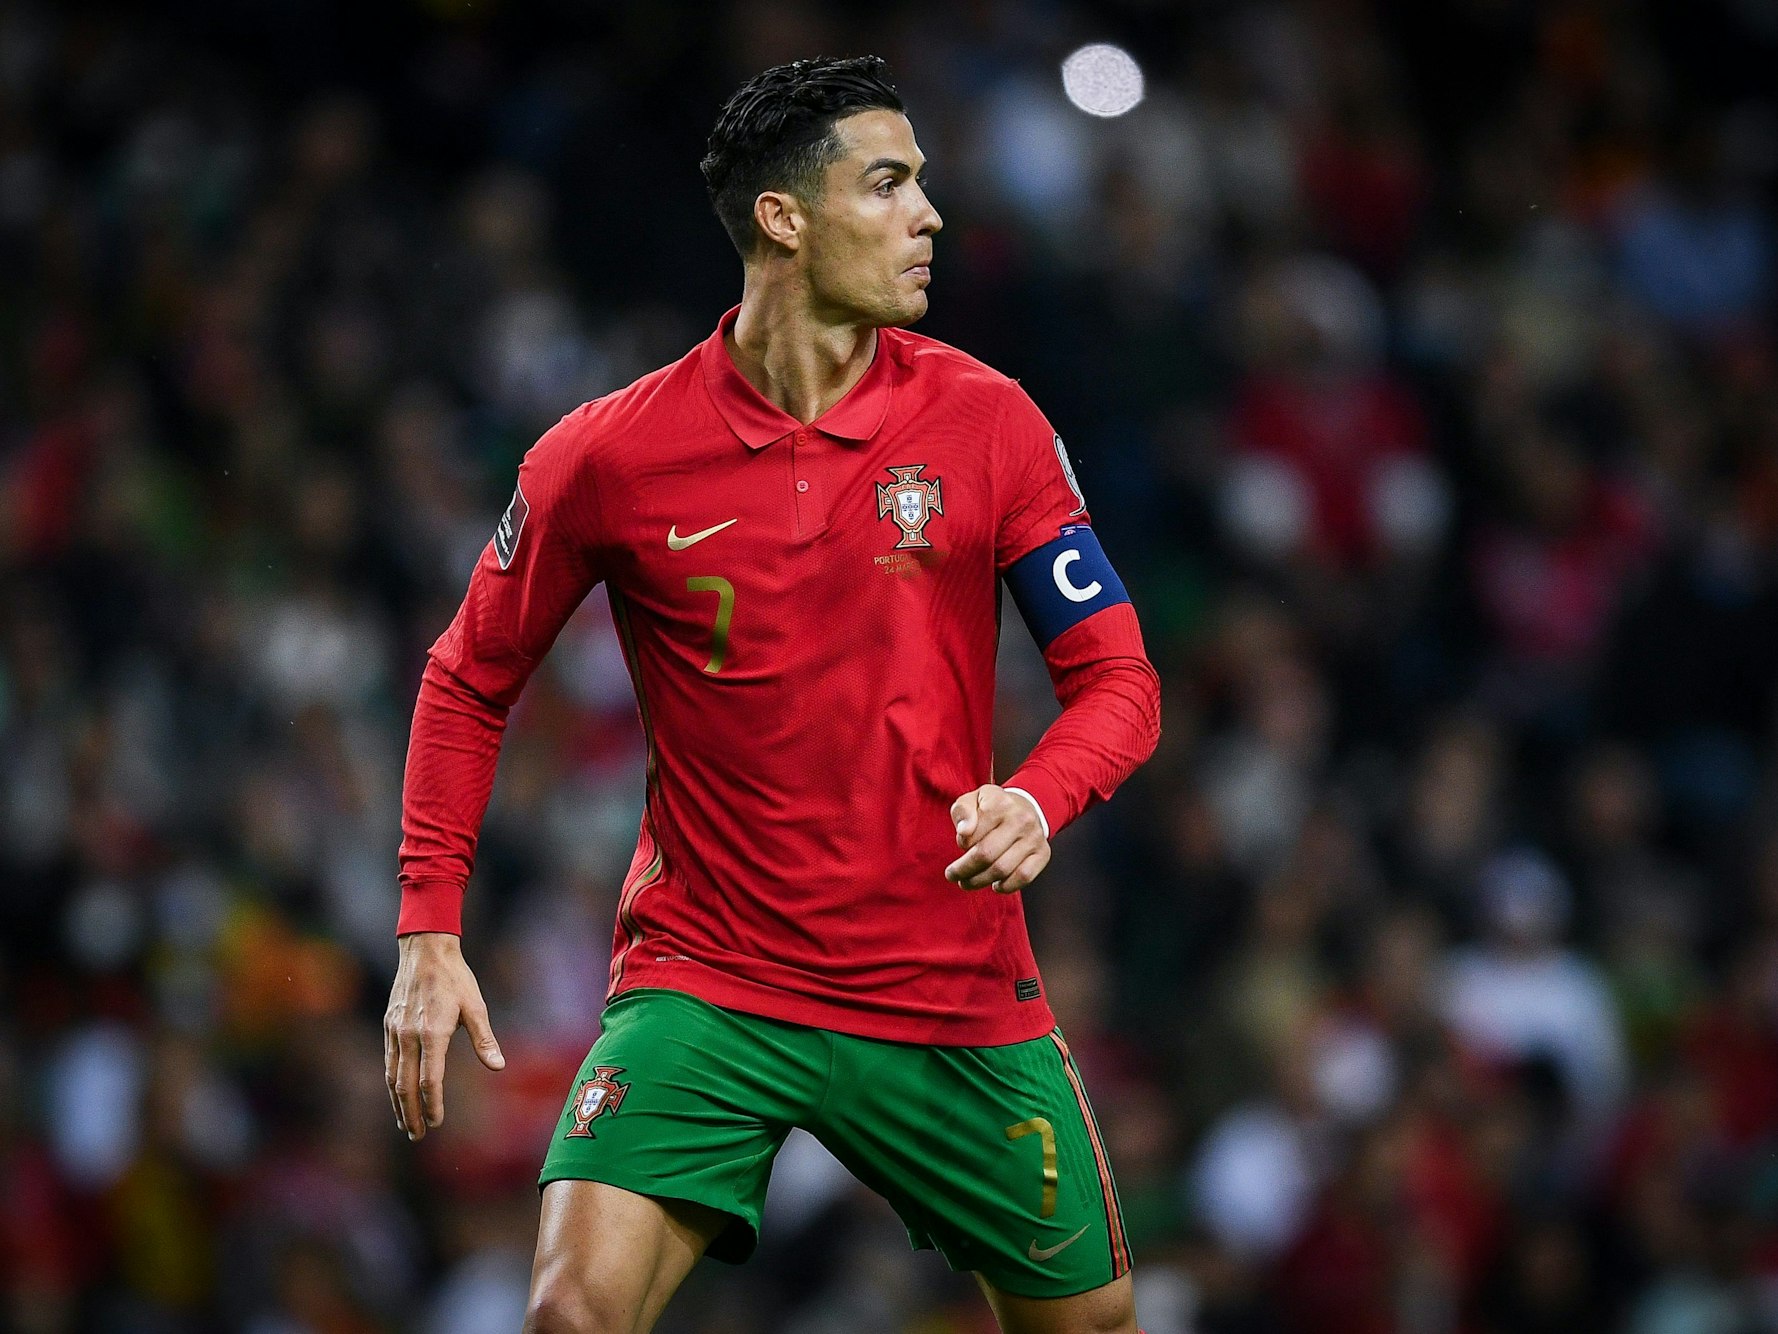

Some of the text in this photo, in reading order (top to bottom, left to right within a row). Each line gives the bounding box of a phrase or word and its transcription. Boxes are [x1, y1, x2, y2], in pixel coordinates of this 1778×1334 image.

[686, 575, 735, 674] 7
[1052, 549, 1102, 602] C
[1005, 1116, 1059, 1218] 7
